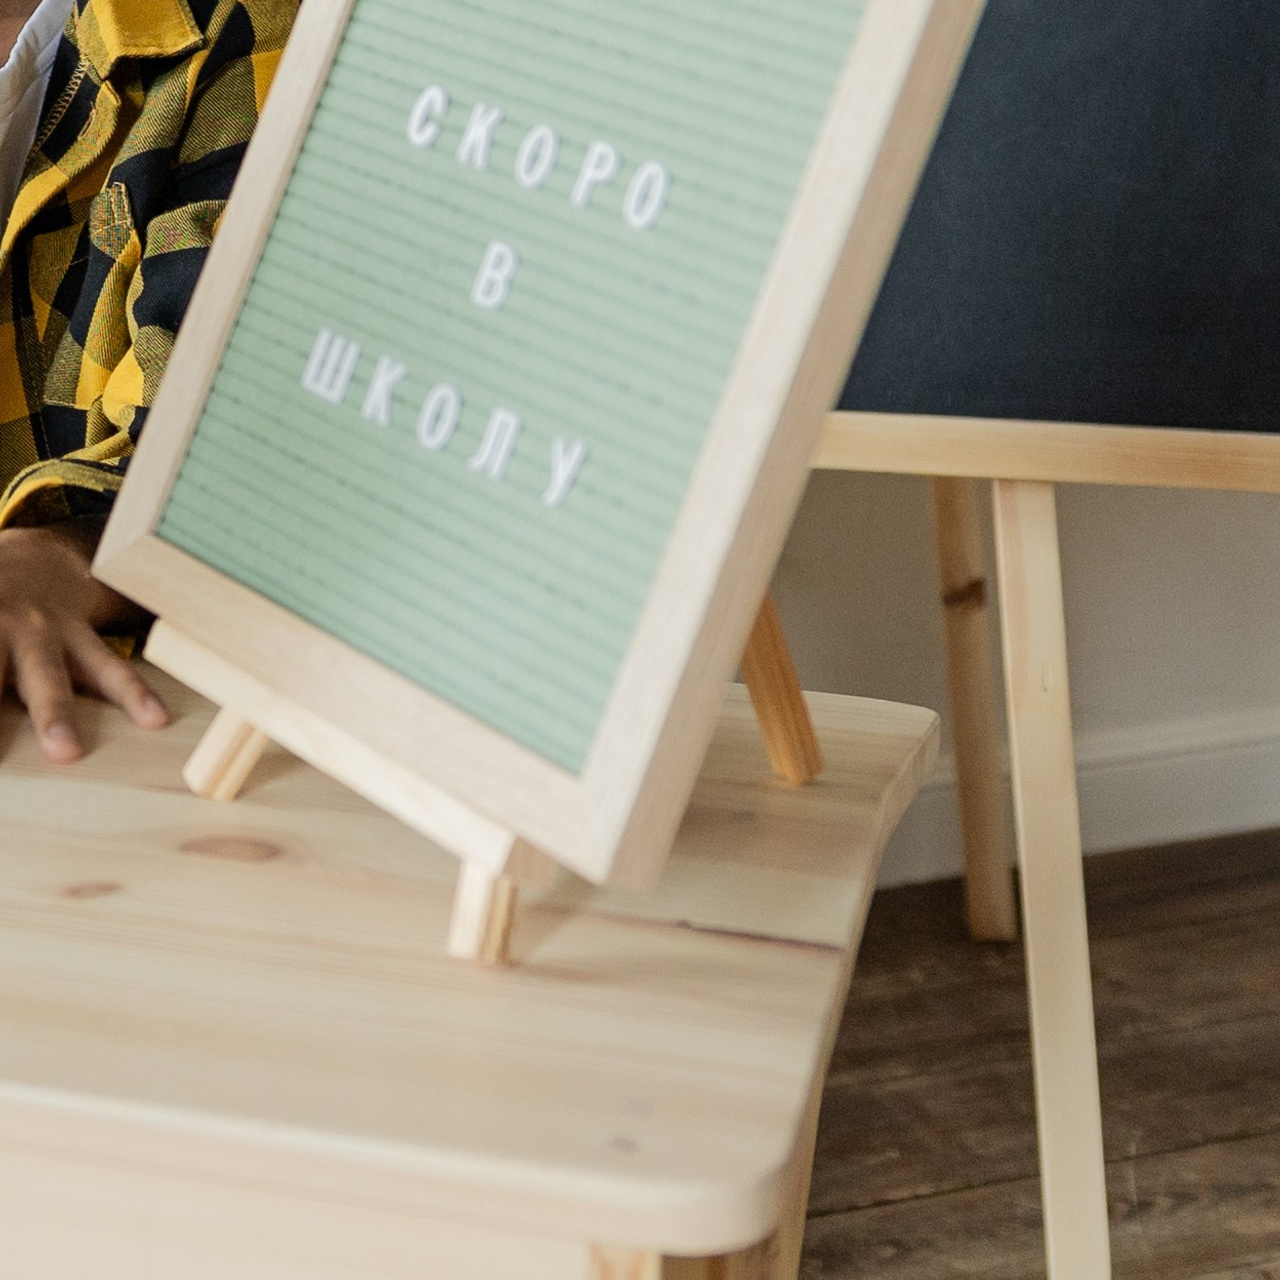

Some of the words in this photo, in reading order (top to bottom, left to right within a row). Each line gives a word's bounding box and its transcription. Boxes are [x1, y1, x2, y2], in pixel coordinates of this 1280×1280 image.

[406, 84, 672, 230] СКОРО
[469, 239, 519, 310] В
[300, 327, 588, 508] ШКОЛУ
